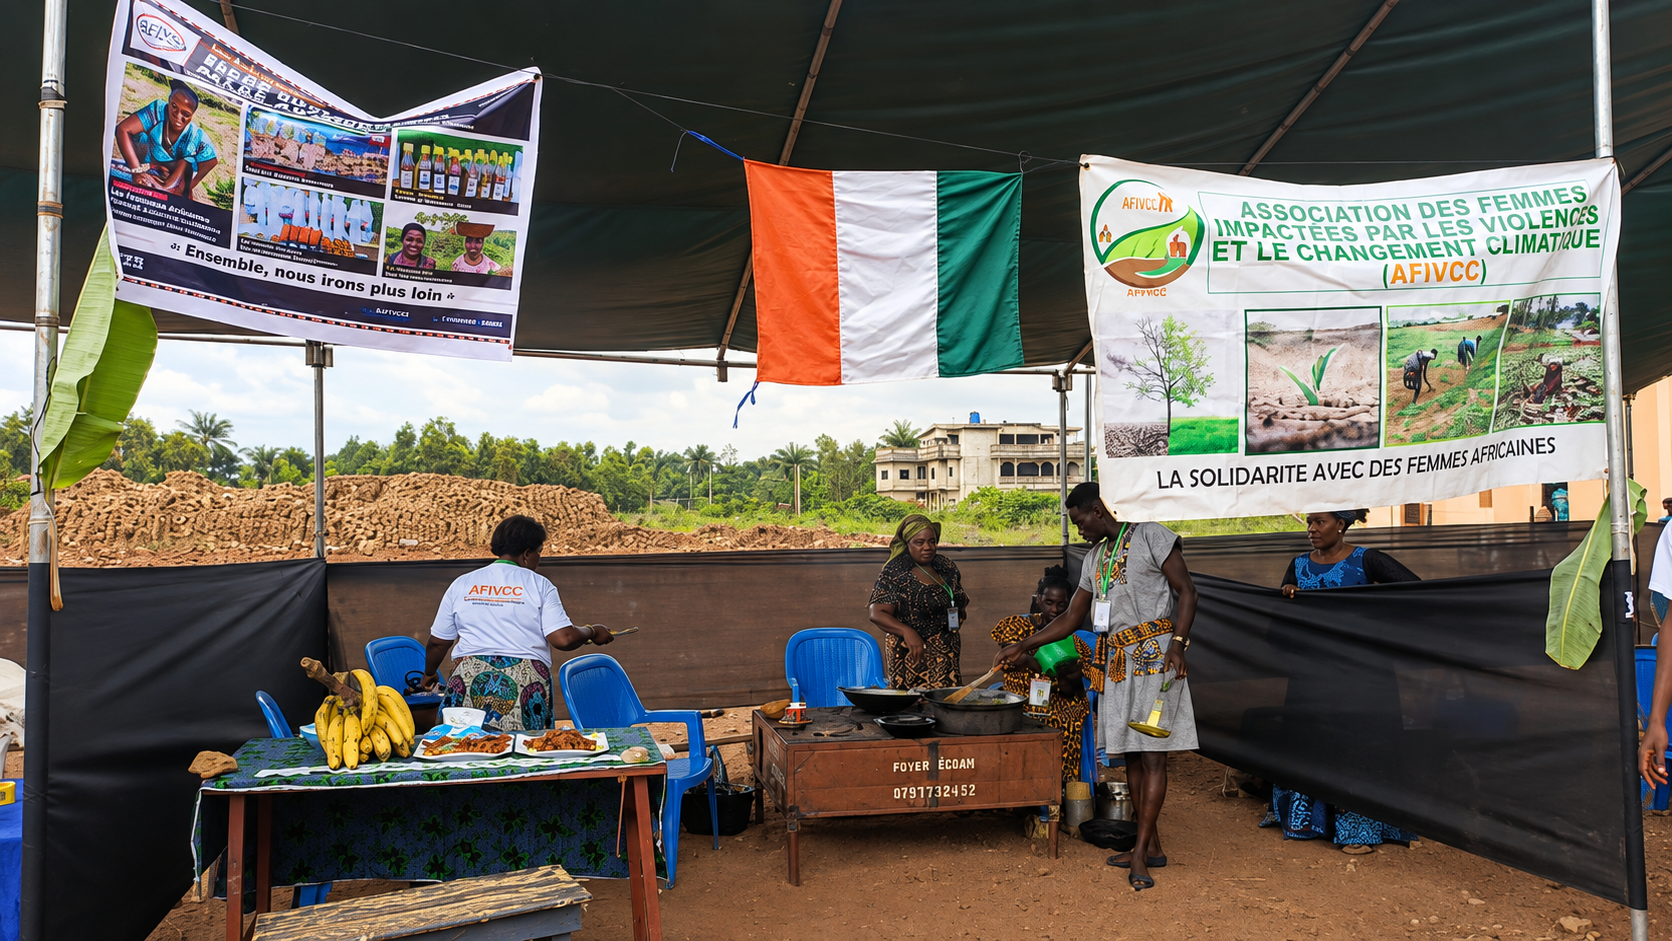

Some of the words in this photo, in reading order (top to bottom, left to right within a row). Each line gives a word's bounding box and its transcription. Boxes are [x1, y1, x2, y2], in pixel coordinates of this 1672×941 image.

[1122, 196, 1158, 211] AFIVCC
[1240, 201, 1412, 223] ASSOCIATION
[1417, 199, 1471, 219] DES
[1477, 185, 1587, 214] FEMMES
[1214, 218, 1359, 242] IMPACTÉES
[1365, 223, 1419, 242] PAR
[1422, 219, 1474, 239] LES
[1478, 204, 1599, 233] VIOLENCES
[1212, 240, 1248, 261] ET
[1257, 241, 1290, 261] LE
[1296, 238, 1476, 261] CHANGEMENT
[1485, 228, 1600, 256] CLIMATIQUE
[185, 243, 269, 277] Ensemble,
[275, 267, 316, 284] nous
[321, 274, 365, 292] irons
[370, 283, 406, 297] plus
[411, 286, 442, 301] loin
[1382, 259, 1487, 289] (AFIVCC)
[1156, 469, 1184, 489] LA
[1190, 464, 1307, 488] SOLIDARITE
[1312, 460, 1364, 482] AVEC
[1369, 458, 1402, 478] DES
[1406, 449, 1469, 475] FEMMES
[1470, 436, 1556, 466] AFRICAINES
[468, 584, 523, 596] AFIVCC
[893, 760, 930, 773] FOYER
[938, 756, 975, 770] ÉCOAM
